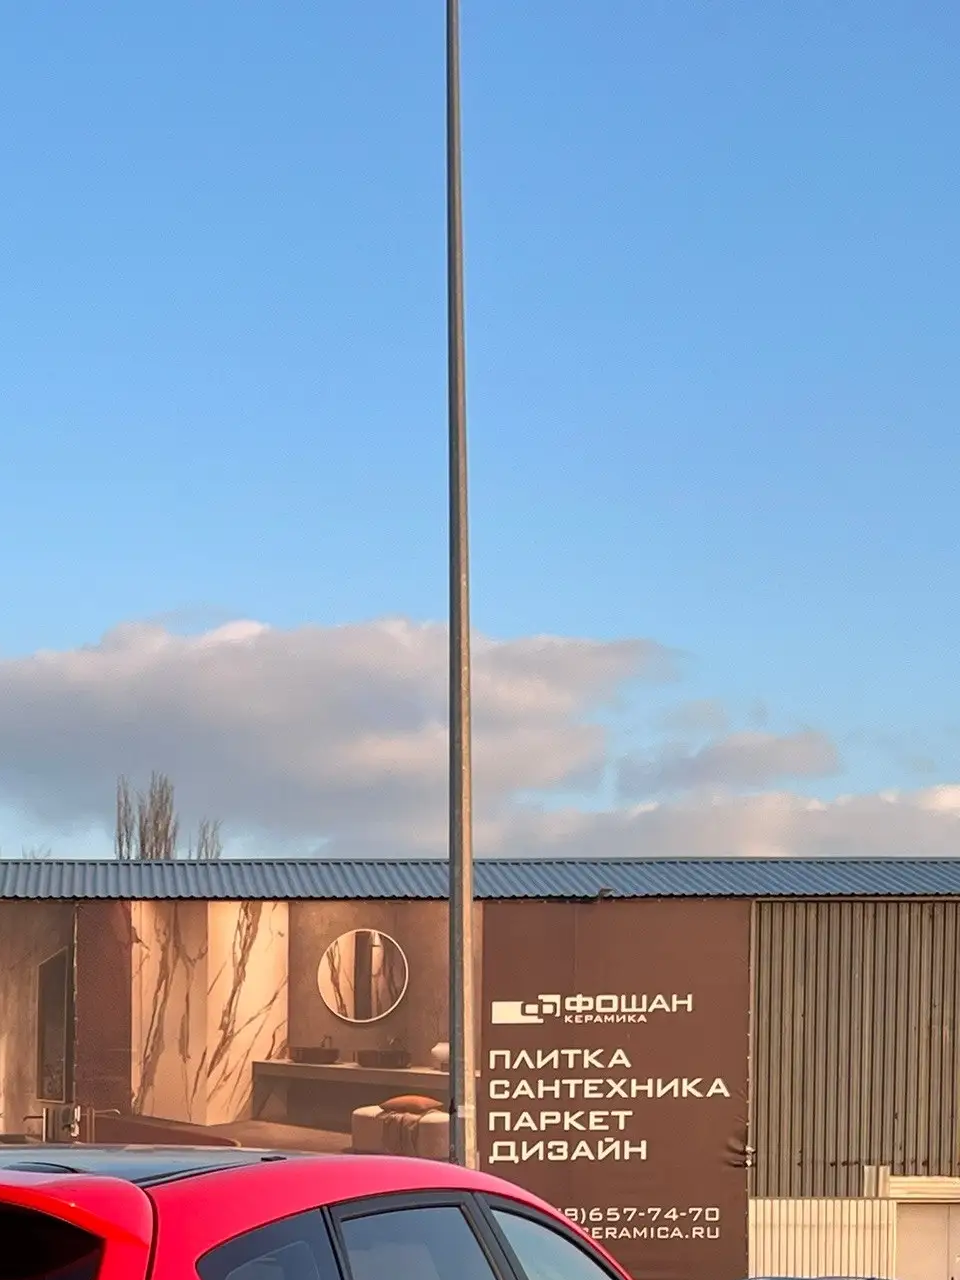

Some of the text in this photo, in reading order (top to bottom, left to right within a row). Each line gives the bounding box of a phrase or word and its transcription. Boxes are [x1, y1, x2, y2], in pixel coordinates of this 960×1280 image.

[564, 993, 693, 1013] ФОШАН
[564, 1014, 647, 1023] КЕРАМИКА
[489, 1049, 633, 1069] ПЛИТКА
[489, 1078, 731, 1099] САНТЕХНИКА
[489, 1110, 633, 1132] ПАРКЕТ
[489, 1137, 648, 1164] ДИЗАЙН
[557, 1207, 720, 1224] 9)657-74-70
[582, 1226, 720, 1239] ERAMICA.RU
